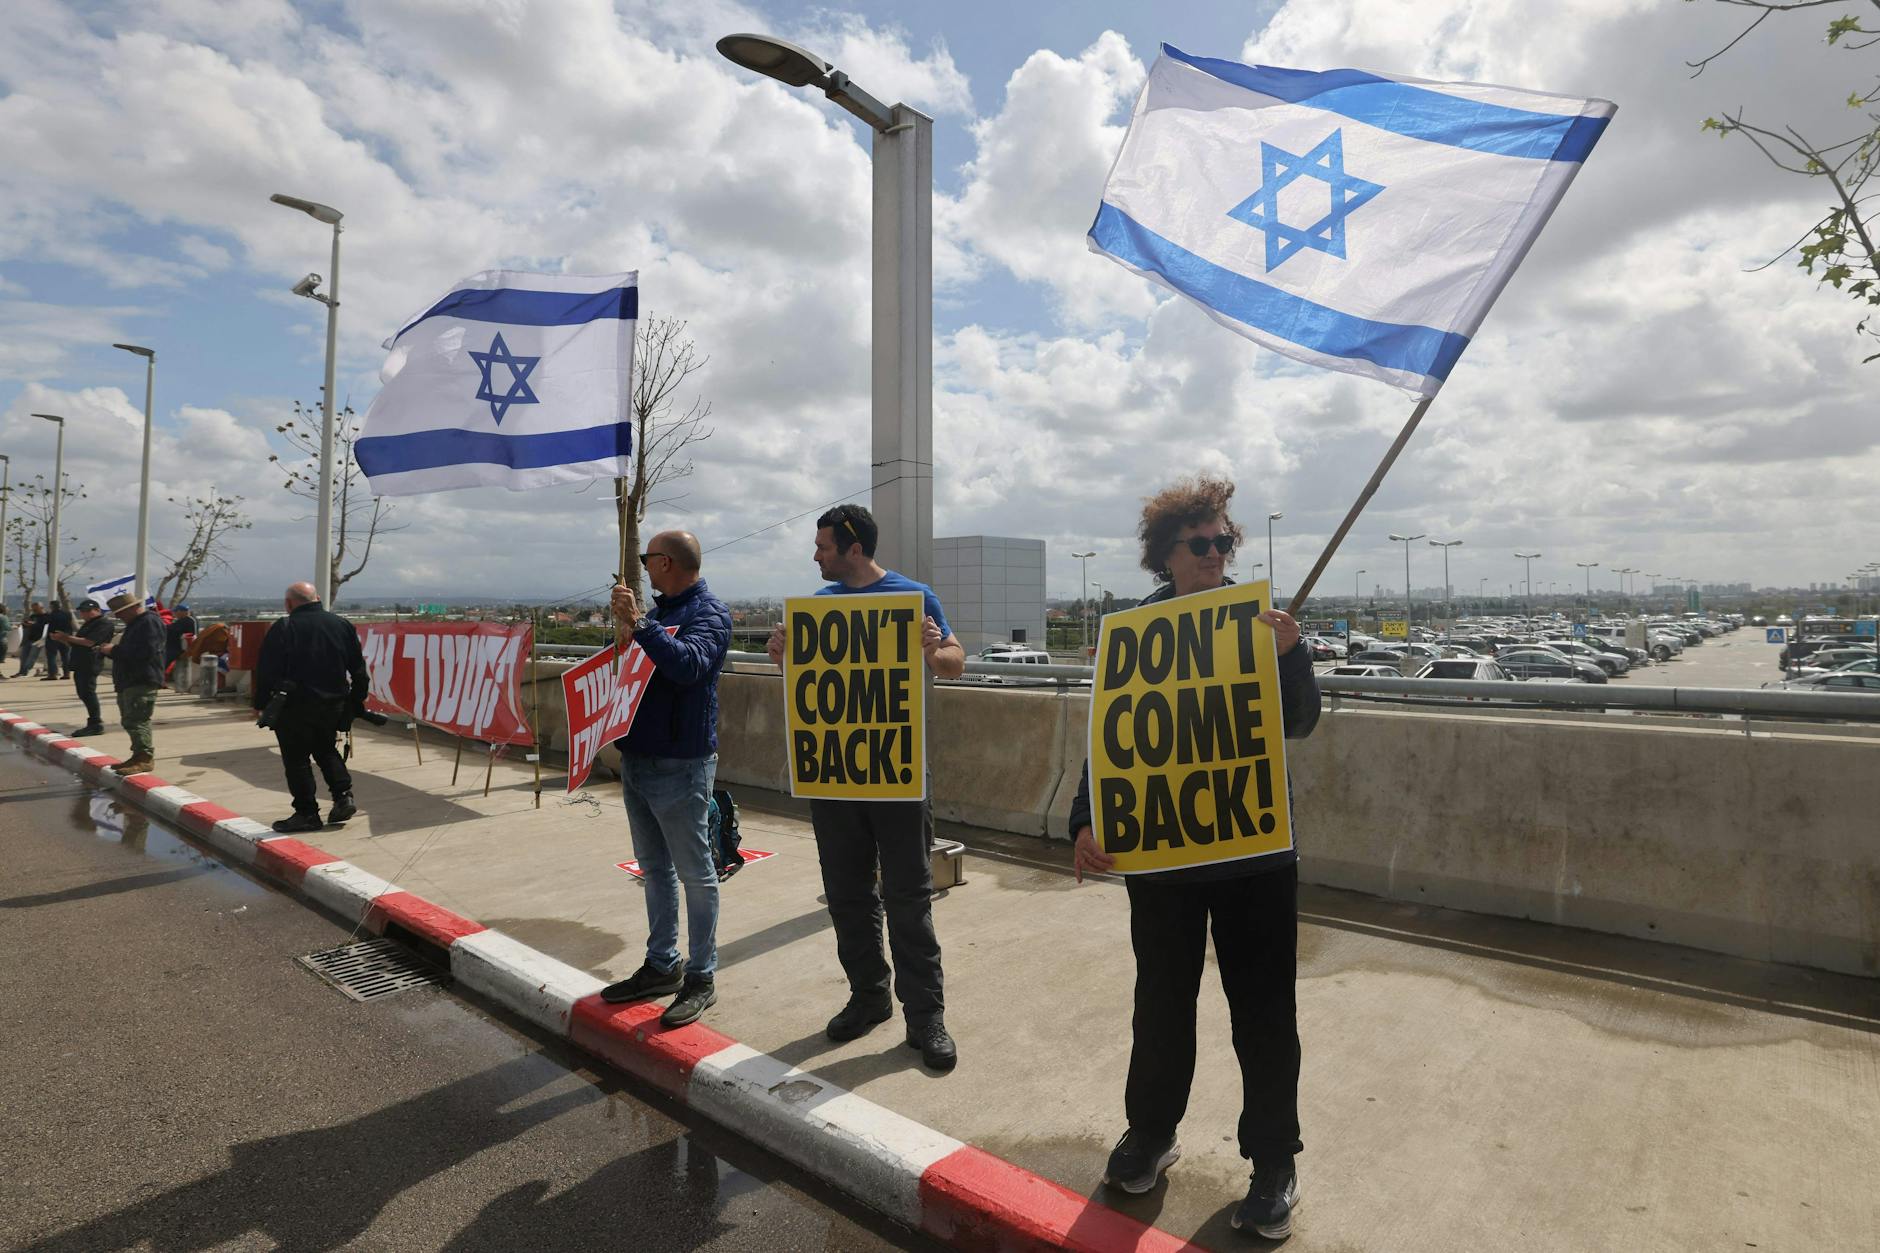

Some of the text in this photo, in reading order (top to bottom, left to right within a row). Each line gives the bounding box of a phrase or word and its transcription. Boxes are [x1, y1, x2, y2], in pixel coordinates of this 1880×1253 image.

[793, 609, 914, 665] DON'T
[1104, 600, 1260, 690] DON'T
[795, 669, 910, 725] COME
[1103, 682, 1266, 769] COME
[793, 726, 912, 785] BACK!
[1100, 758, 1276, 853] BACK!
